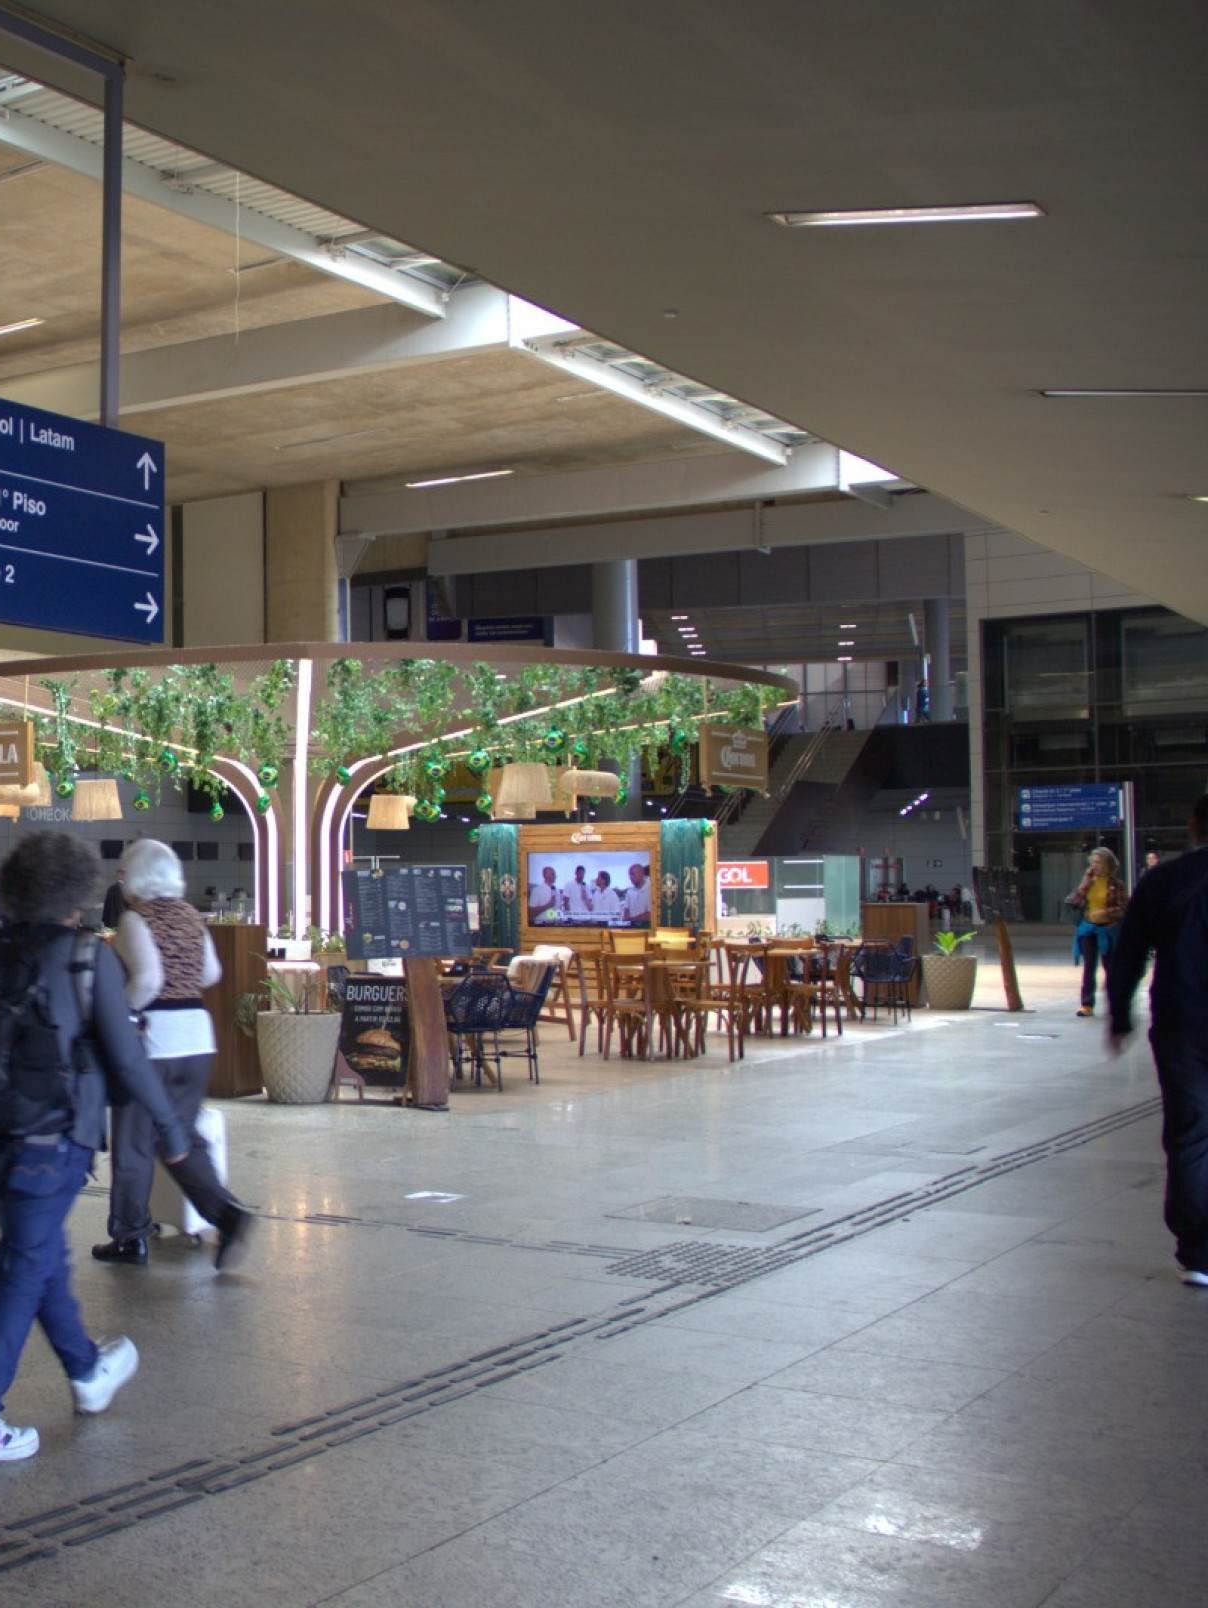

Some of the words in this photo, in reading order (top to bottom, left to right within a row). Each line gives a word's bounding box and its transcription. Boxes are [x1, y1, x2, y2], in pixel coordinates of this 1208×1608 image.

[30, 422, 75, 452] Latam
[13, 491, 46, 516] Piso
[5, 564, 15, 584] 2
[28, 807, 80, 822] CHECK
[716, 867, 753, 884] GOL
